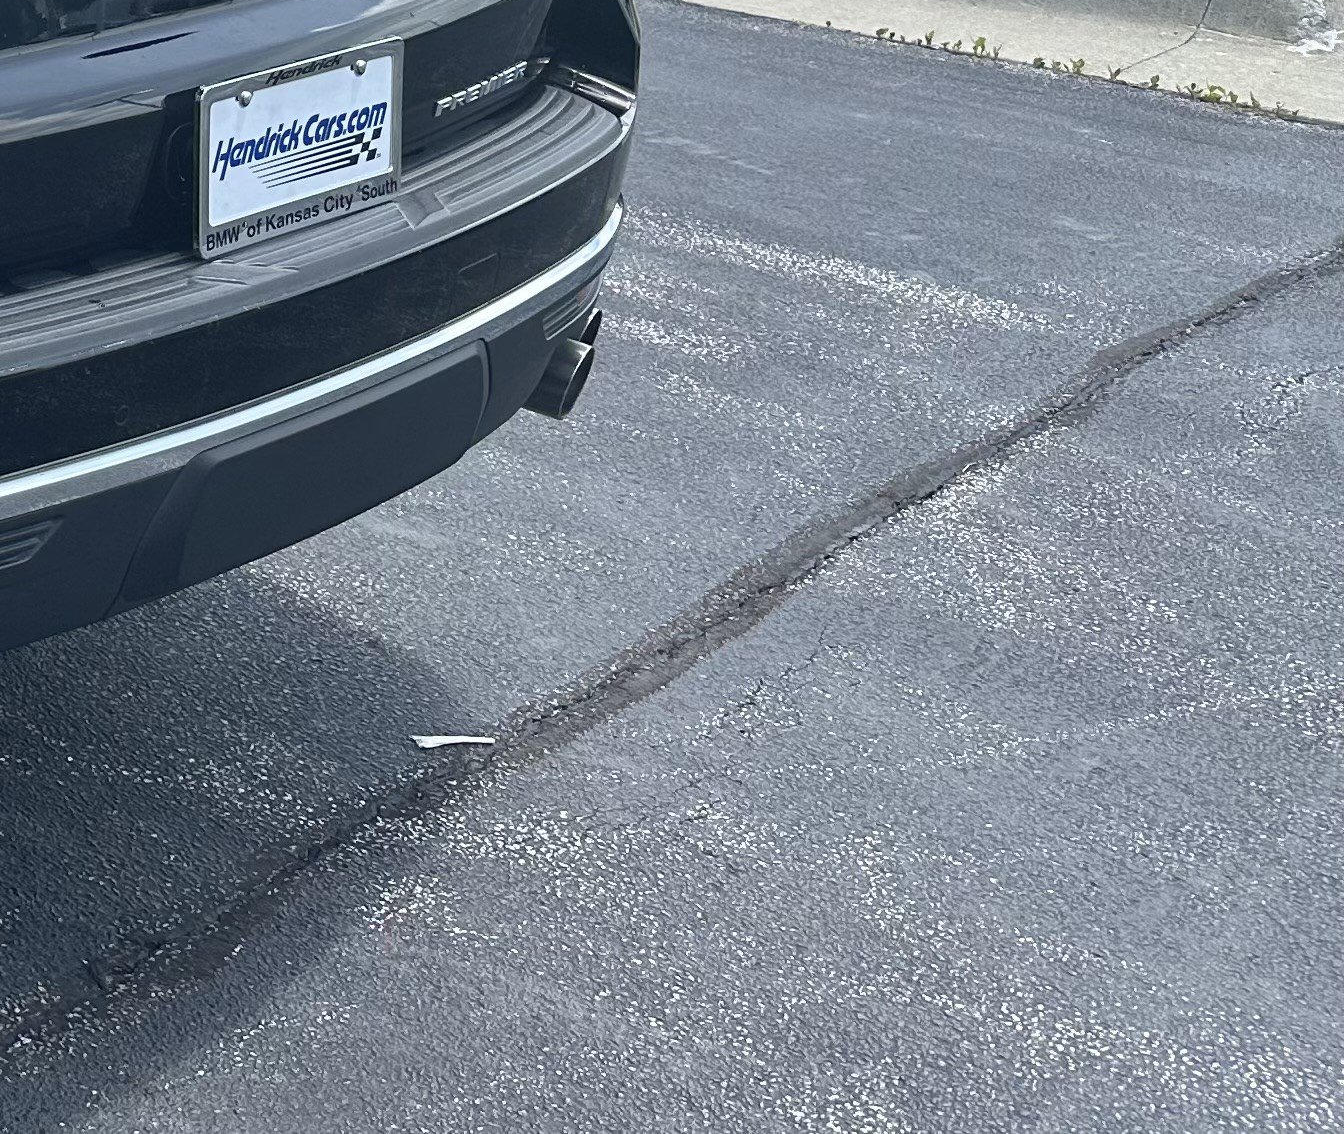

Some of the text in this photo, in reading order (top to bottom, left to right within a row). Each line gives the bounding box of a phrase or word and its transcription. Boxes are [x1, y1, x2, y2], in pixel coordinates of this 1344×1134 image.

[265, 55, 344, 85] Hendrick
[434, 61, 528, 118] PREMIER
[206, 179, 398, 252] BMW of Kansas City South
